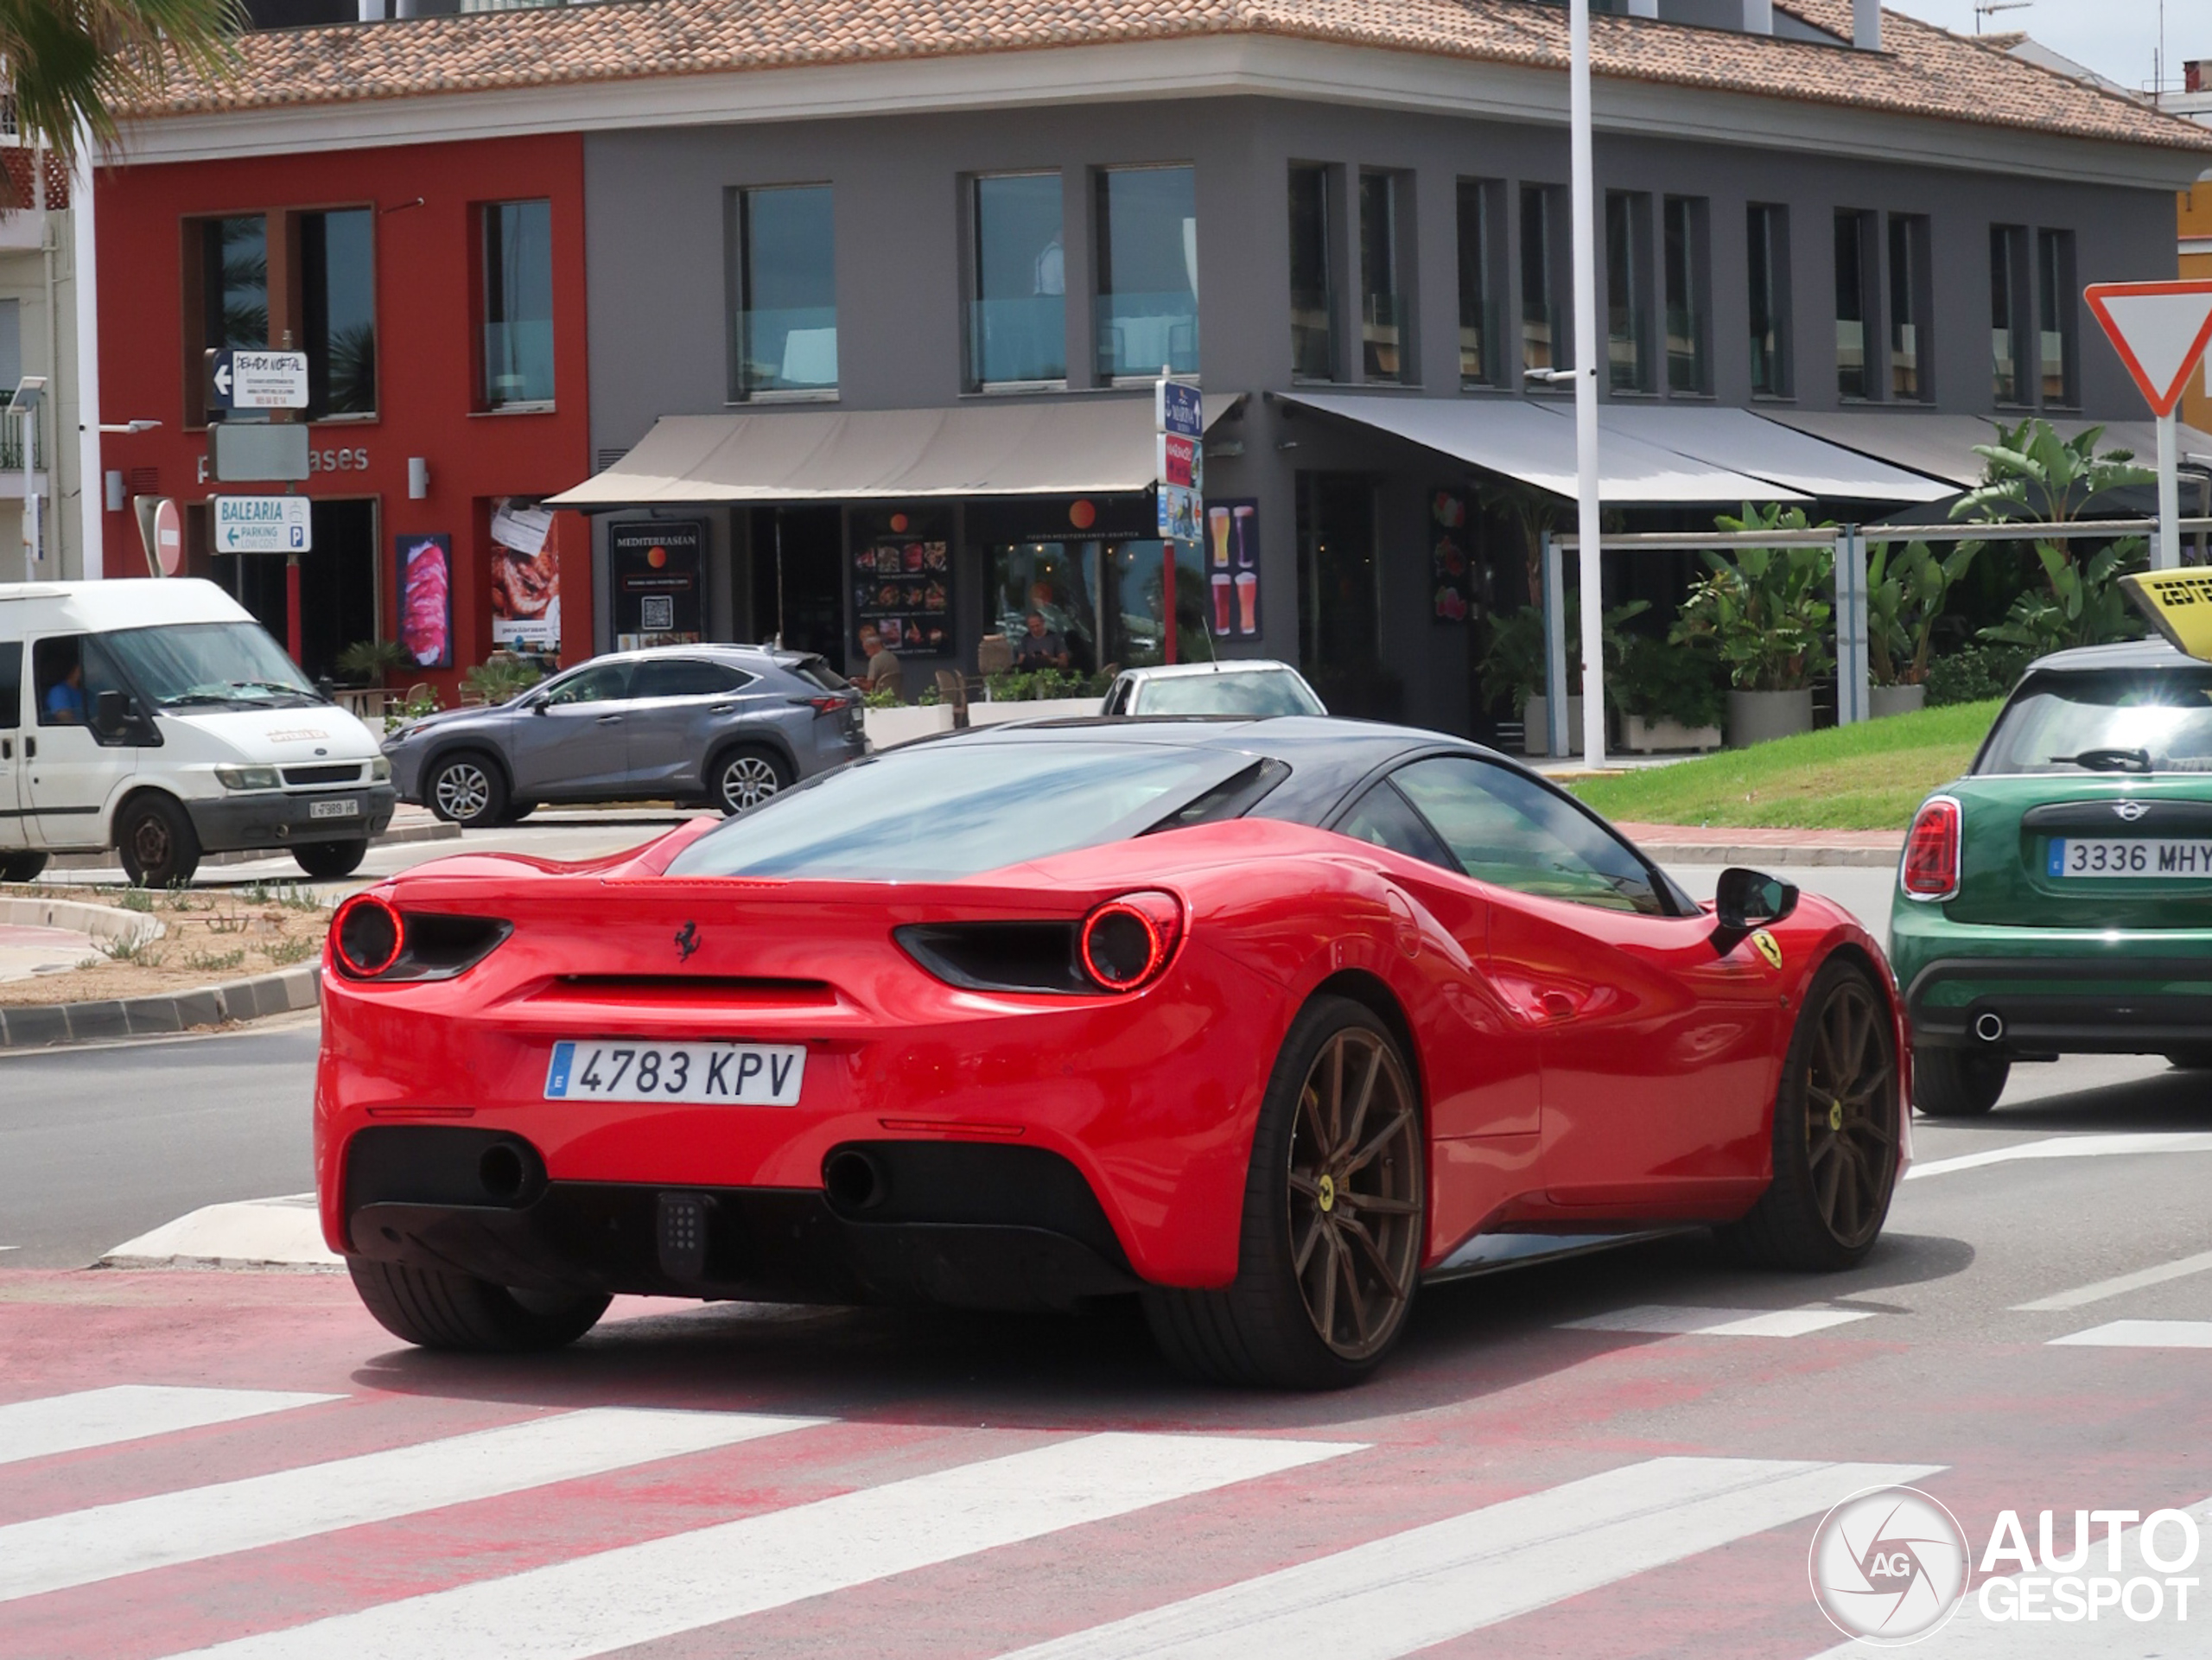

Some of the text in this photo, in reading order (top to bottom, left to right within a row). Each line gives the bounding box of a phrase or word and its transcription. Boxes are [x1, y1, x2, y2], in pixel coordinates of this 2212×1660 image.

[241, 527, 277, 538] PARKING
[260, 538, 277, 548] COST
[617, 536, 696, 547] MEDITERRASIAN
[2071, 845, 2147, 871] 3336
[2158, 845, 2212, 872] MHY
[580, 1049, 690, 1094] 4783
[705, 1051, 795, 1097] KPV
